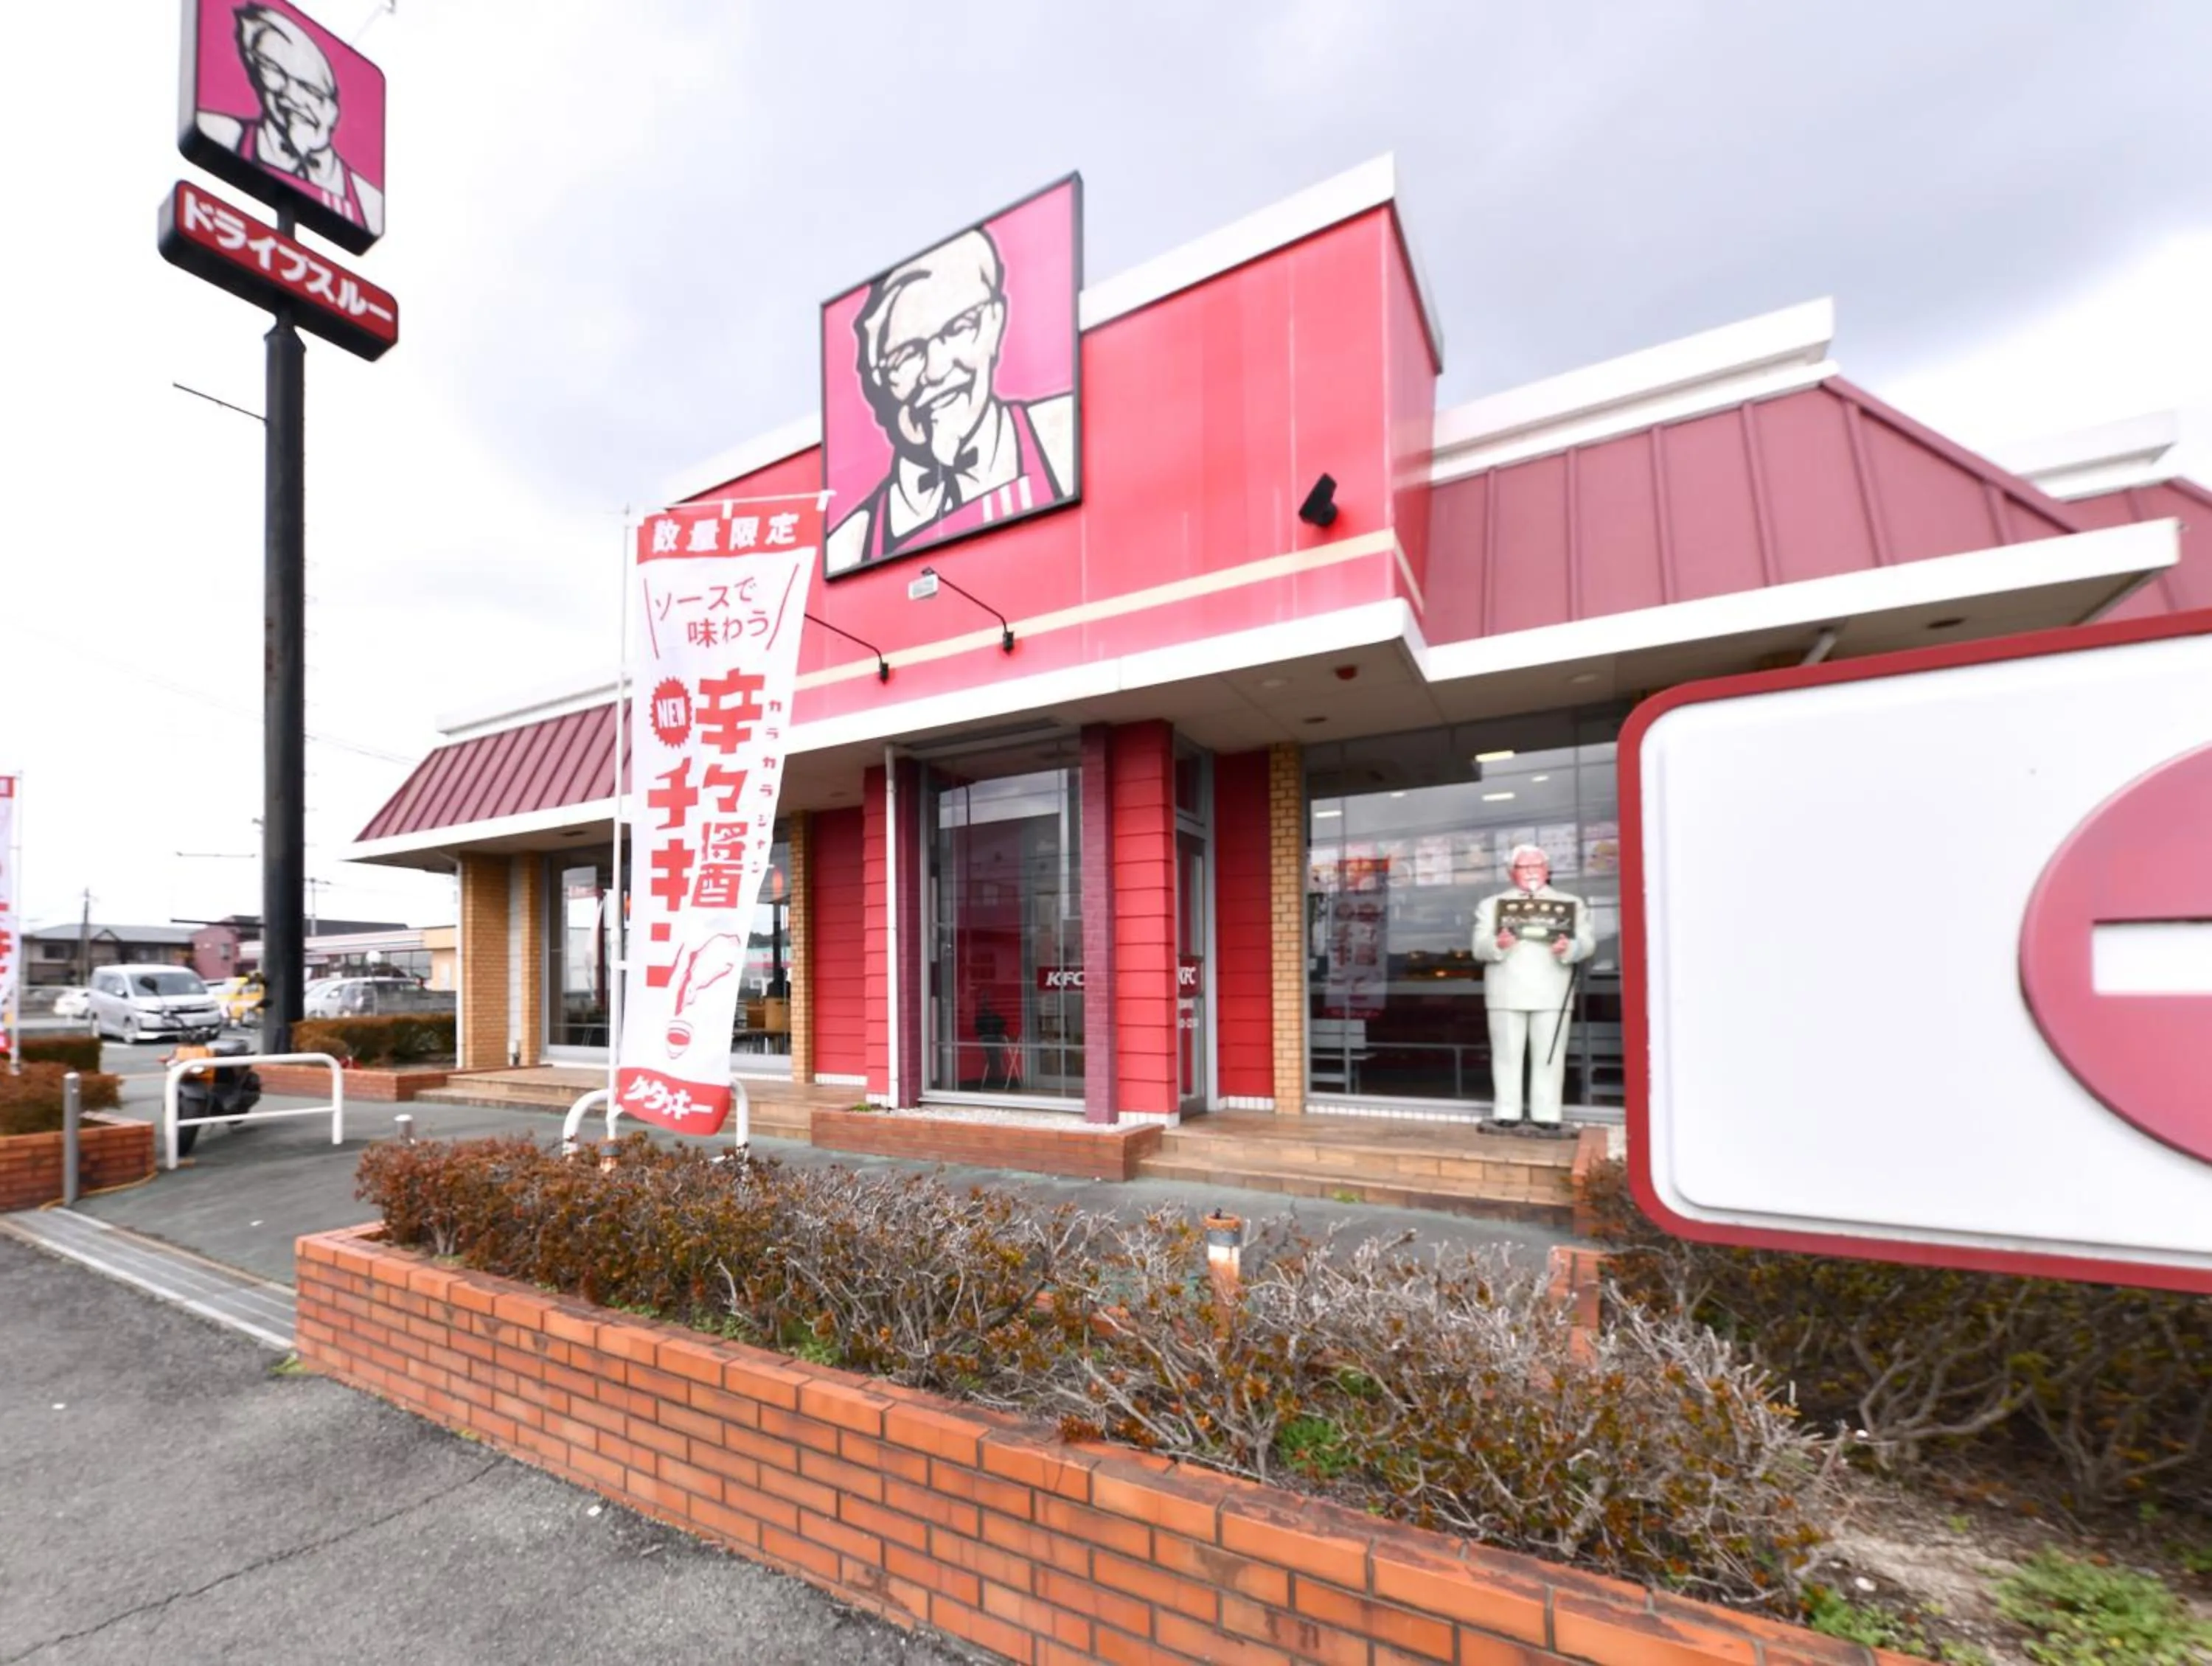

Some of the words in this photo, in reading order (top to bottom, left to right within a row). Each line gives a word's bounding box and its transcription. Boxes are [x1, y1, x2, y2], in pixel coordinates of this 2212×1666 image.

[651, 512, 800, 554] 数量限定
[655, 576, 757, 621] ソースで
[687, 610, 769, 648] 味わう
[646, 756, 699, 988] チキン
[1046, 971, 1085, 986] KFC
